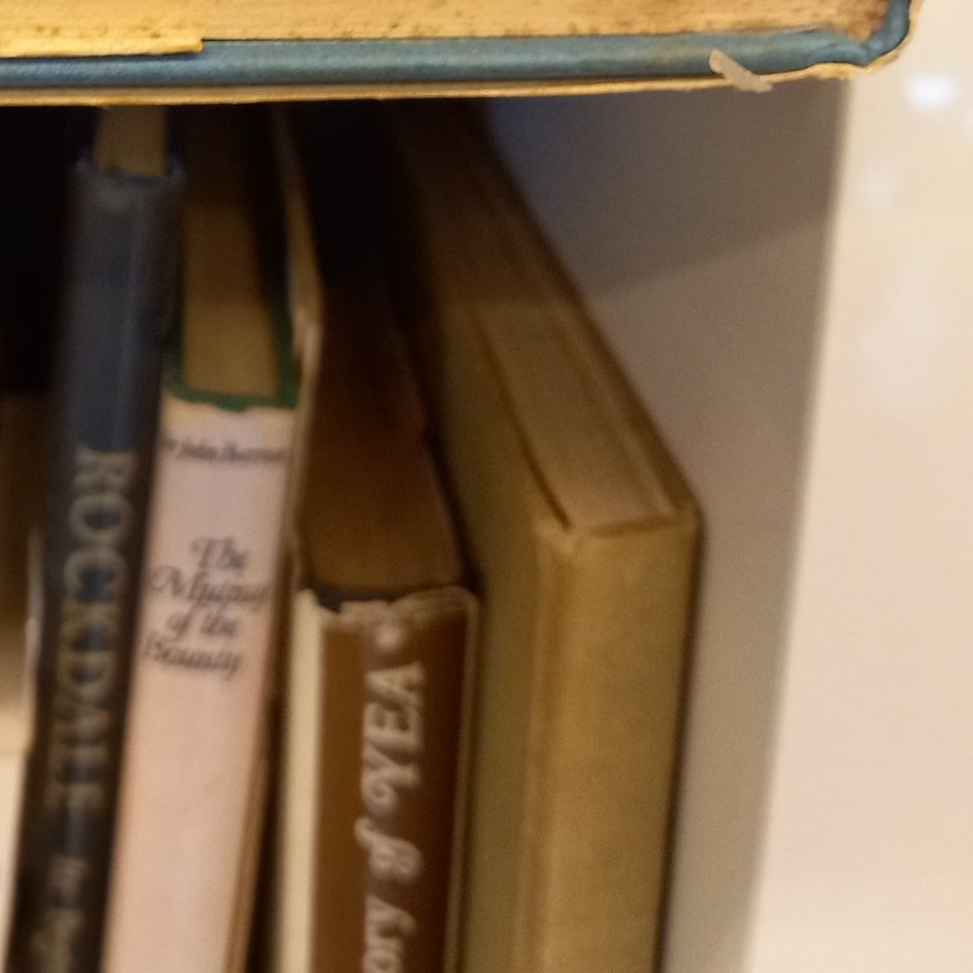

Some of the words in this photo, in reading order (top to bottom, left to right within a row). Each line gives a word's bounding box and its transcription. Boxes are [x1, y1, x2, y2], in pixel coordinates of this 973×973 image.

[191, 536, 248, 570] The
[151, 565, 268, 612] Mutiny
[45, 447, 137, 813] ROCKDALE
[167, 601, 205, 640] of
[202, 603, 238, 637] the
[146, 632, 243, 679] Bounty
